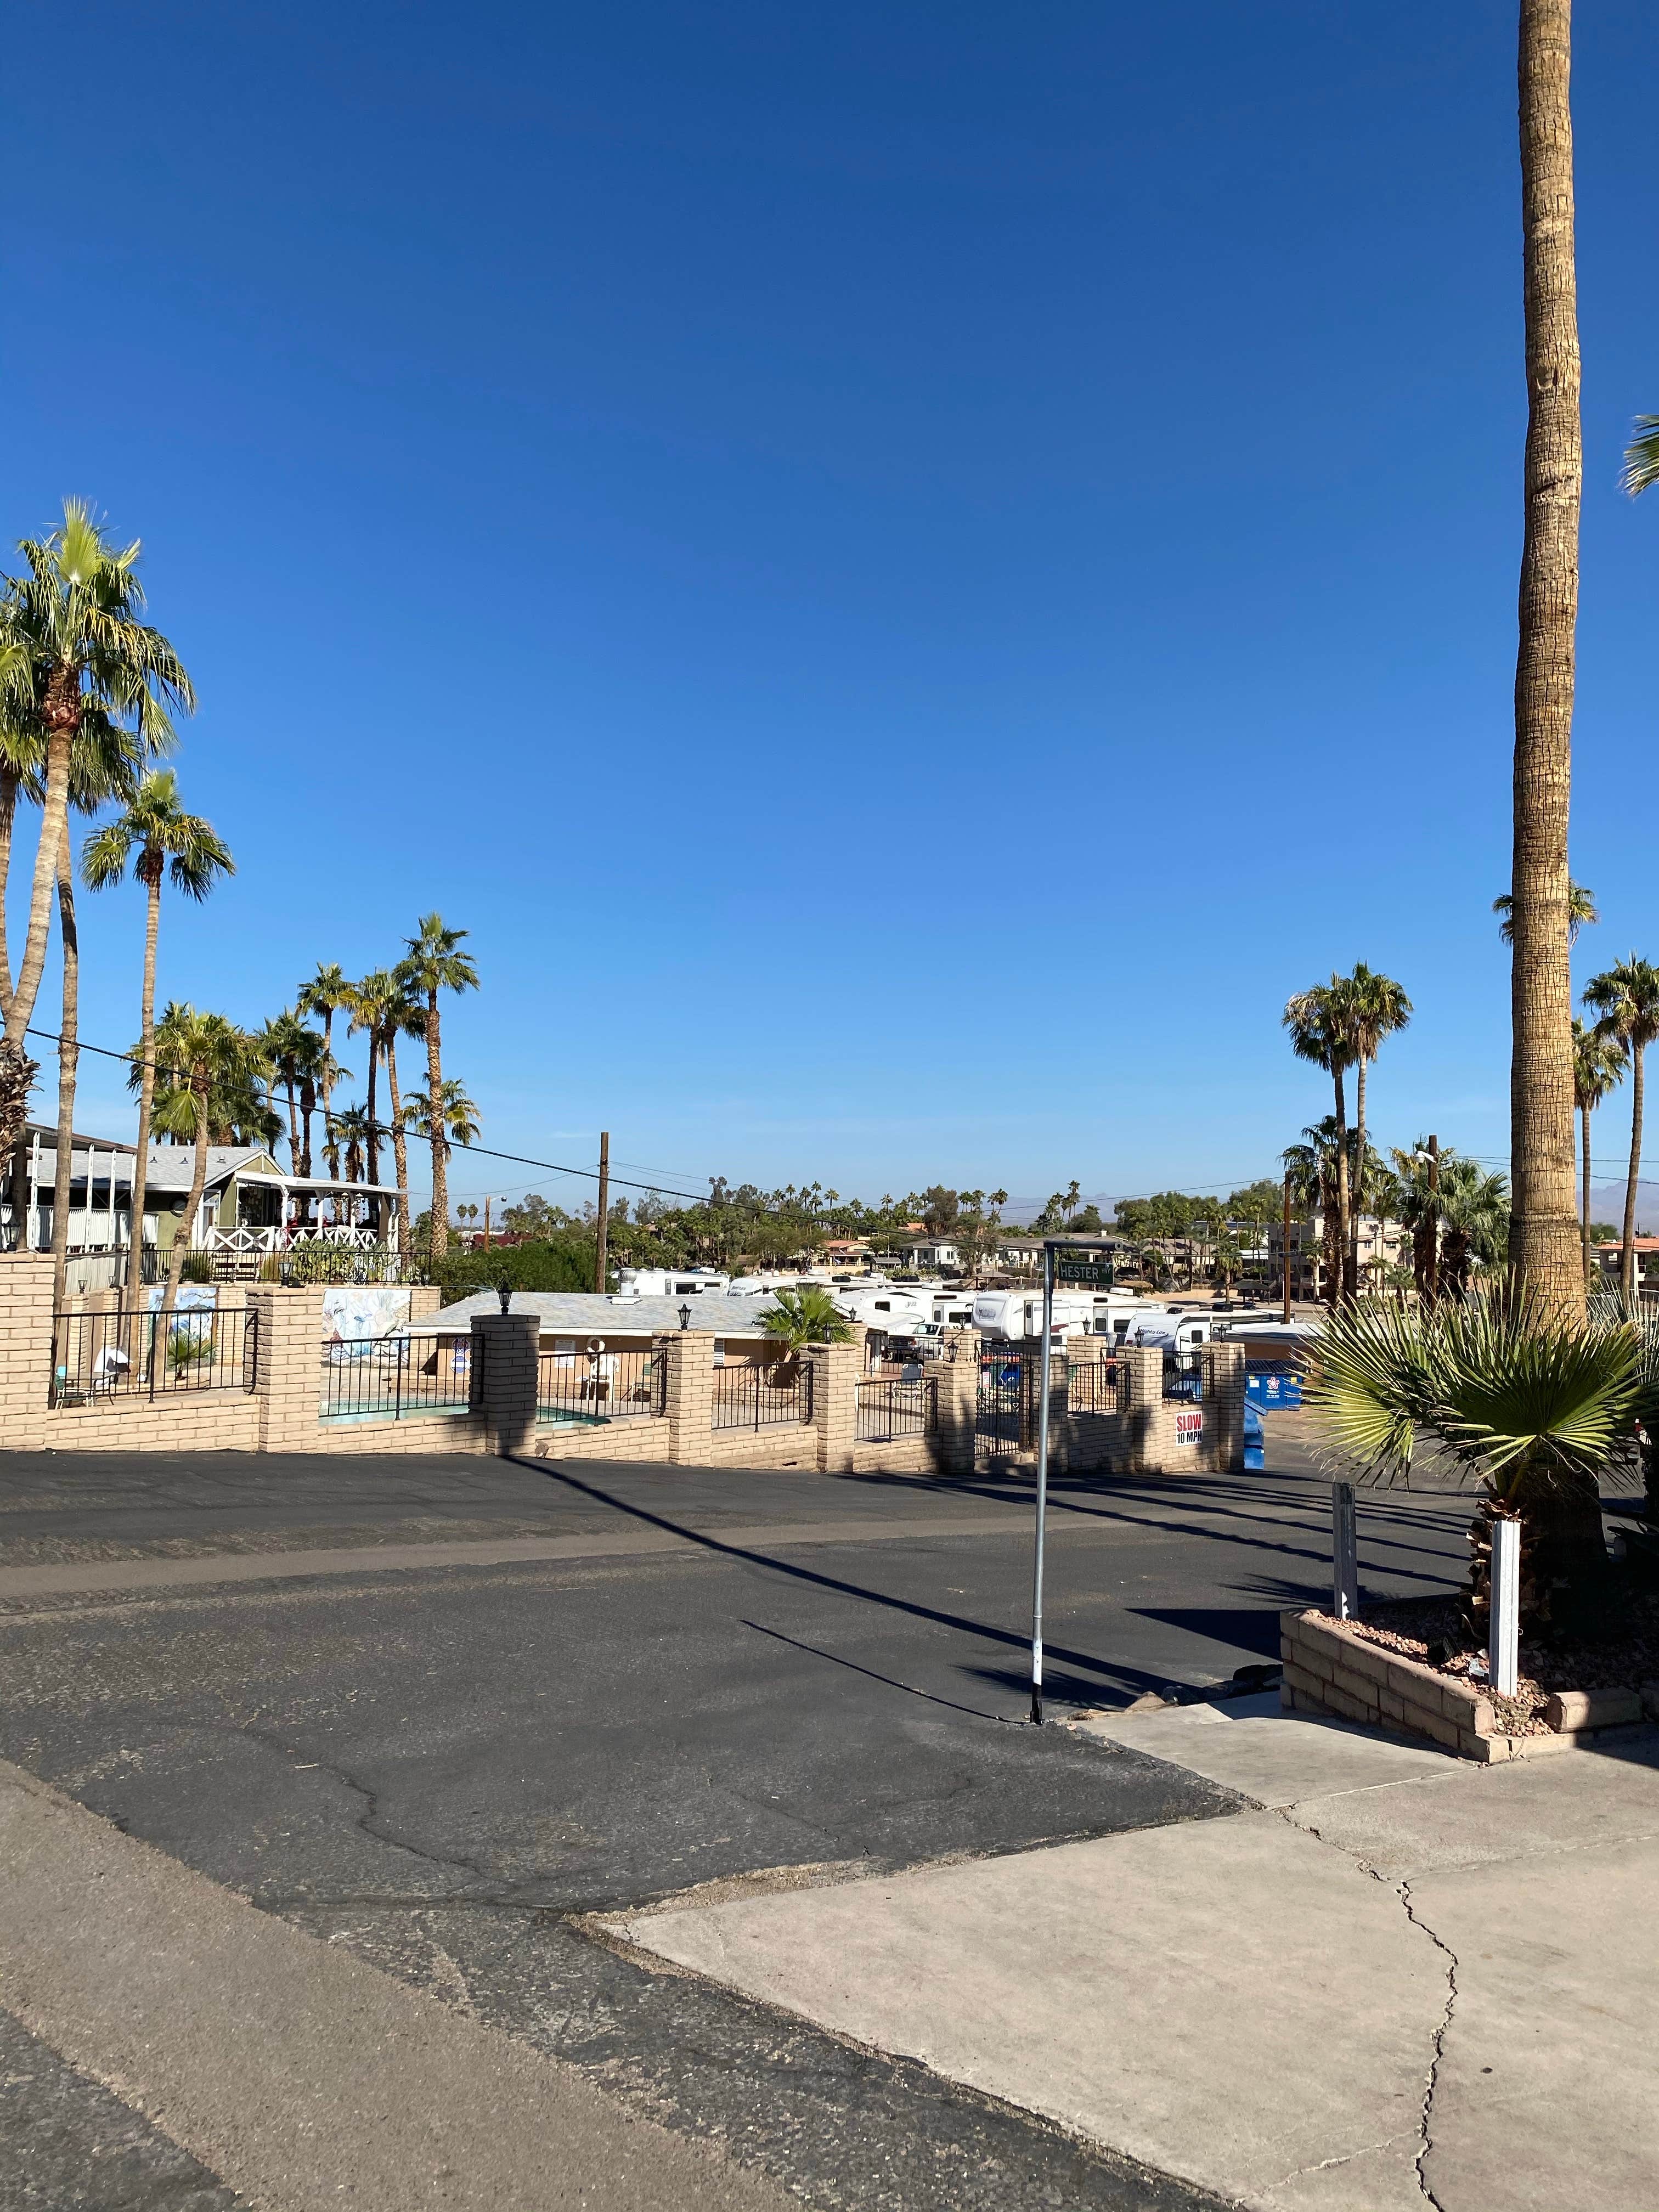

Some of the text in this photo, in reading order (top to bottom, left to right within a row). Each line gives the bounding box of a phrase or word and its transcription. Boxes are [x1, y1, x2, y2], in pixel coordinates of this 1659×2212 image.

[1060, 1265, 1099, 1279] HESTER
[1177, 1414, 1201, 1432] SLOW
[1177, 1430, 1201, 1443] 10 MPH
